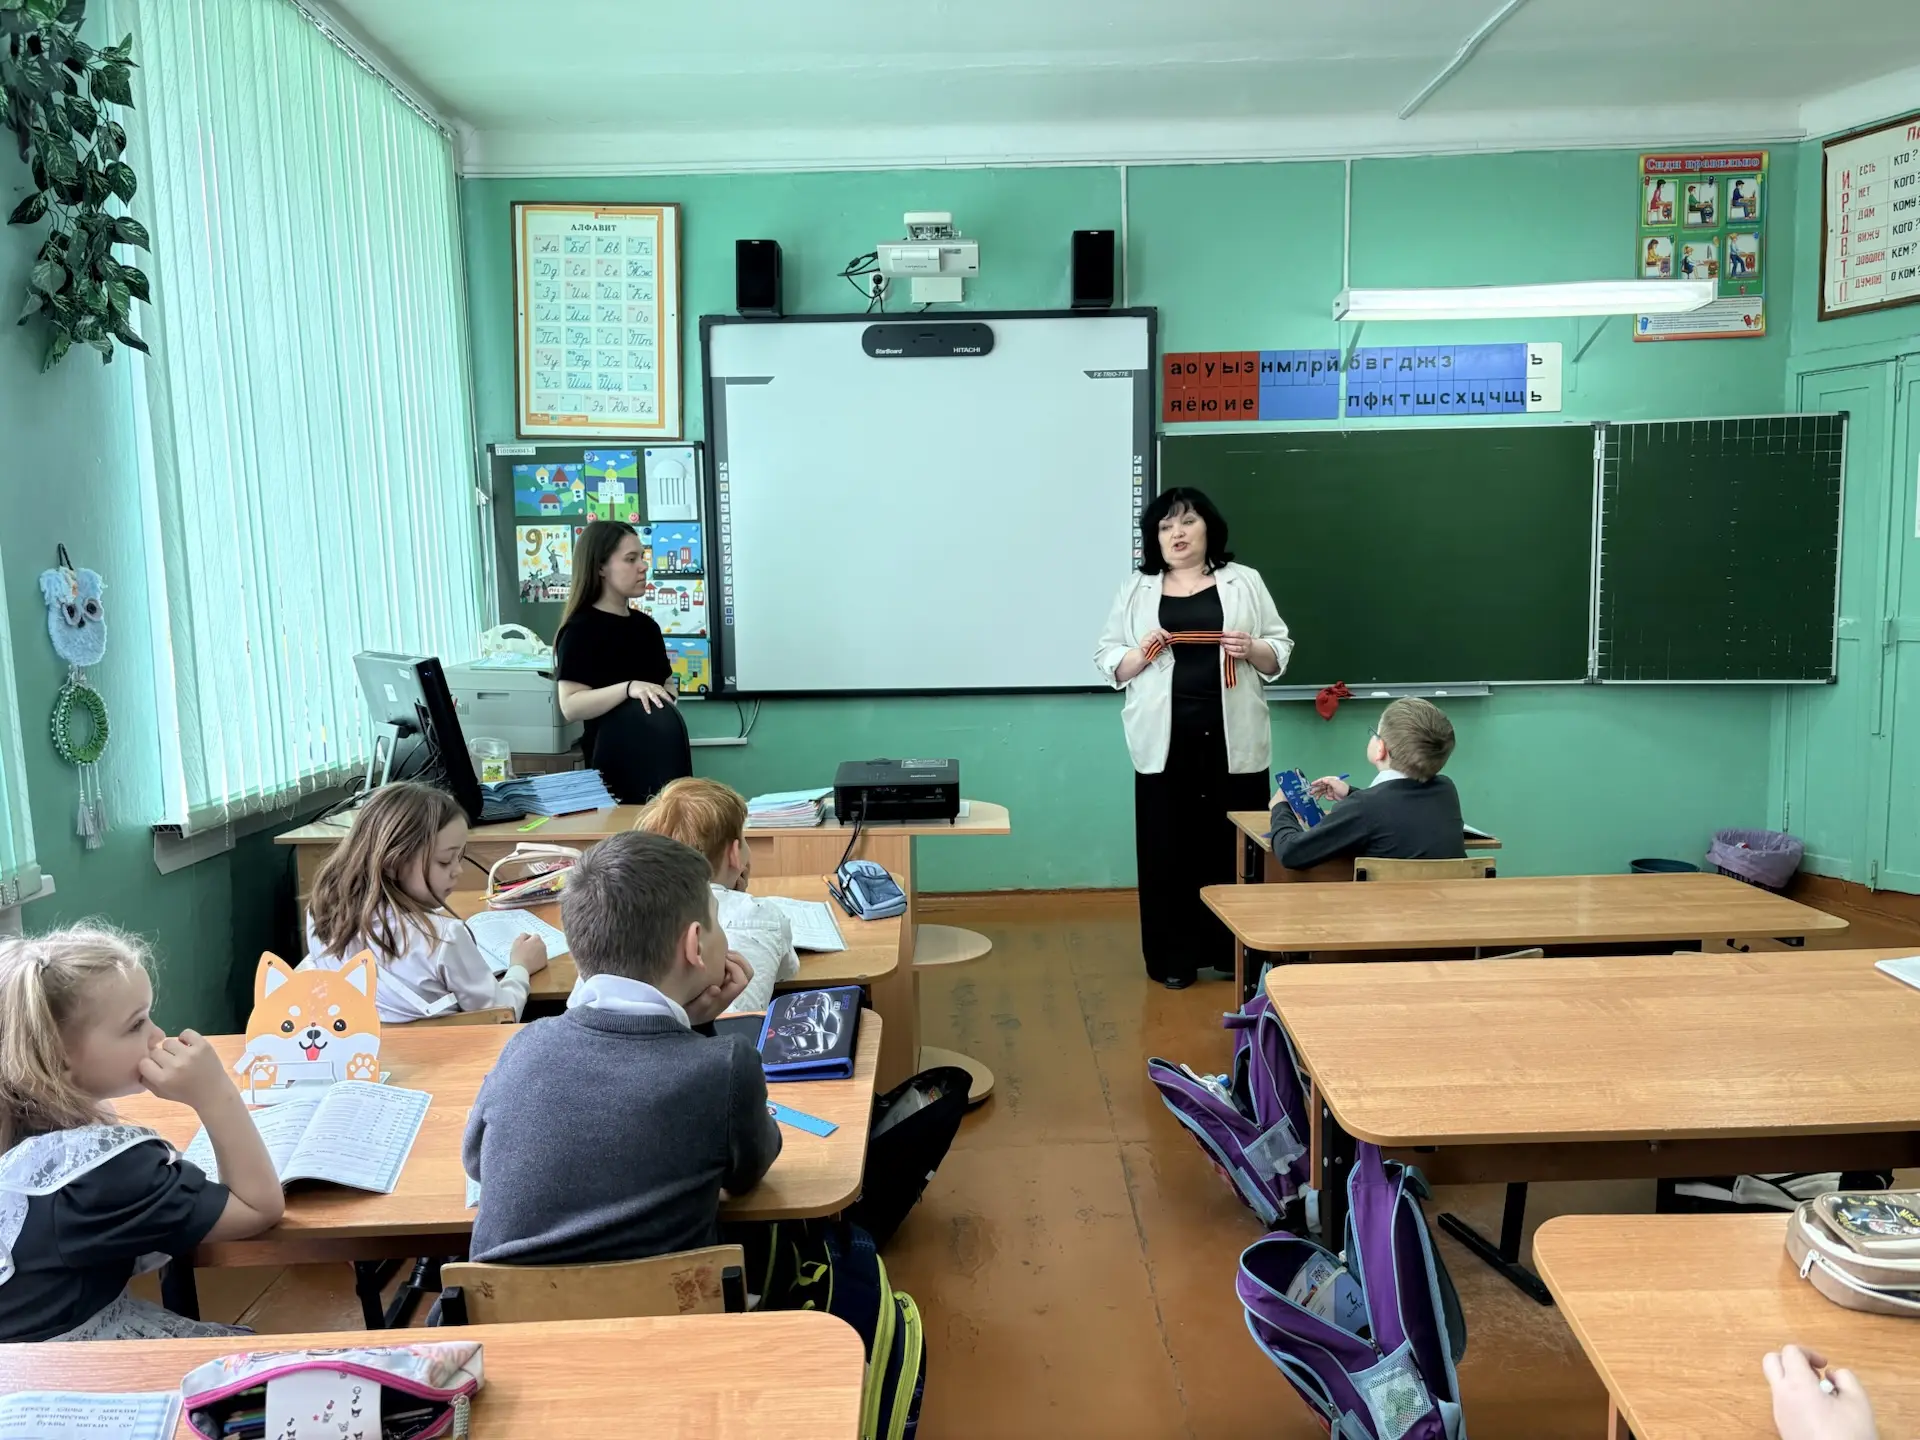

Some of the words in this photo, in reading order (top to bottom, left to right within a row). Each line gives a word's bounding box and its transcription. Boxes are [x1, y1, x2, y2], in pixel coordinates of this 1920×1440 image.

[1646, 159, 1681, 172] Сиди
[1685, 158, 1760, 171] правильно
[1860, 163, 1876, 176] ЕСТЬ
[1858, 186, 1871, 198] НЕТ
[1858, 208, 1875, 220] ДАМ
[570, 224, 616, 232] АЛФАВИТ
[1857, 229, 1880, 242] ВИЖУ
[1856, 251, 1885, 266] ДОВОЛЕН
[526, 528, 542, 556] 9
[1346, 1292, 1357, 1305] 2
